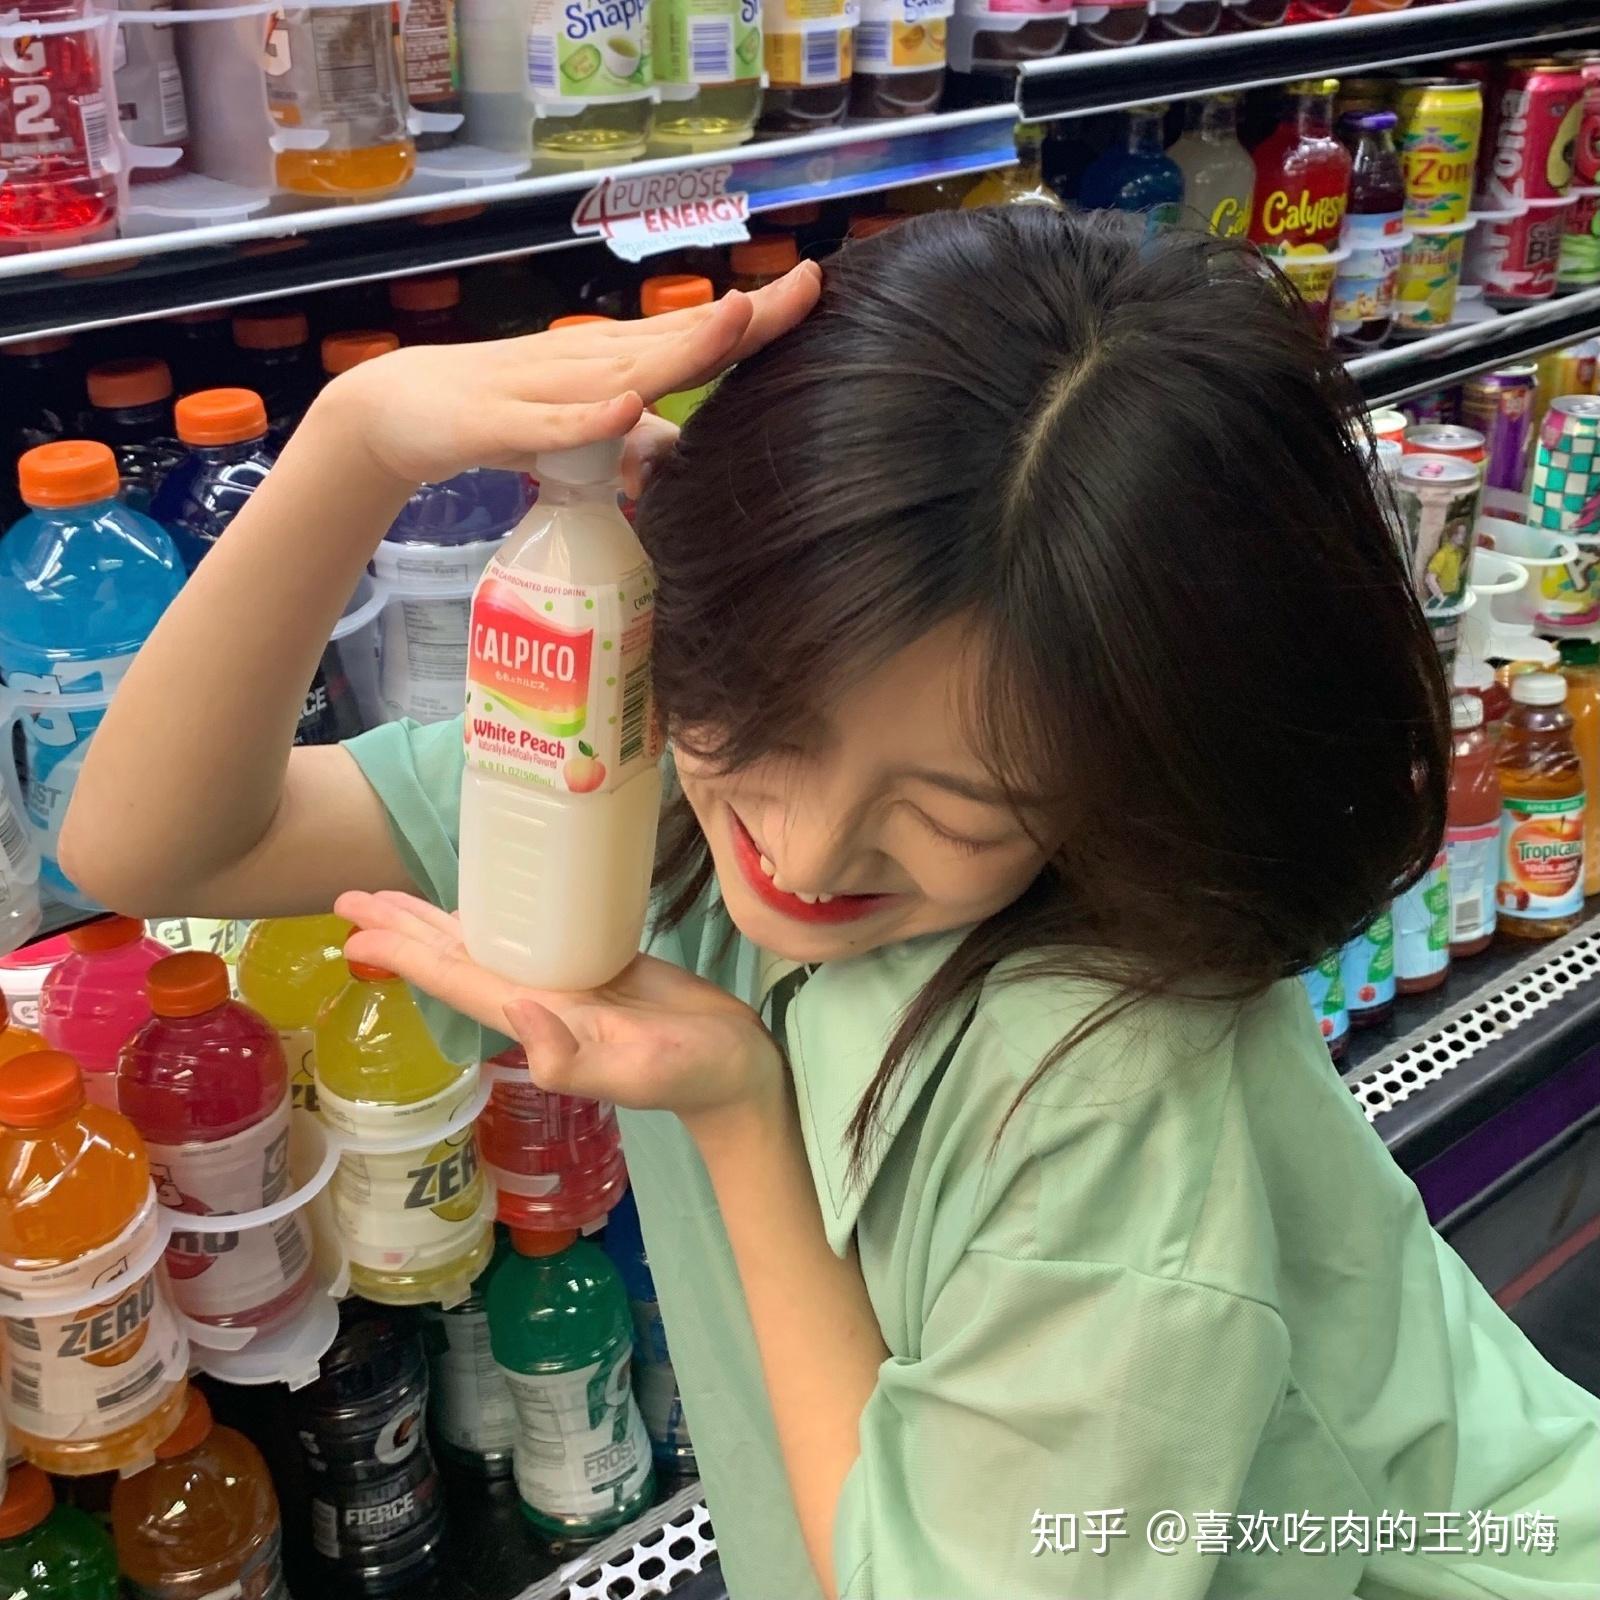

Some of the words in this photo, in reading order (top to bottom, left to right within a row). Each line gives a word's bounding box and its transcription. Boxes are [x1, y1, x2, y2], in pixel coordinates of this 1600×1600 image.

[13, 84, 60, 135] 2
[577, 176, 641, 239] 4
[613, 169, 727, 211] PURPOSE
[641, 197, 745, 234] ENERGY
[563, 588, 587, 597] DRINK
[475, 623, 574, 682] CALPICO
[299, 686, 327, 718] CE
[473, 719, 516, 744] White
[520, 730, 565, 759] Peach
[345, 1492, 415, 1525] FIERCE
